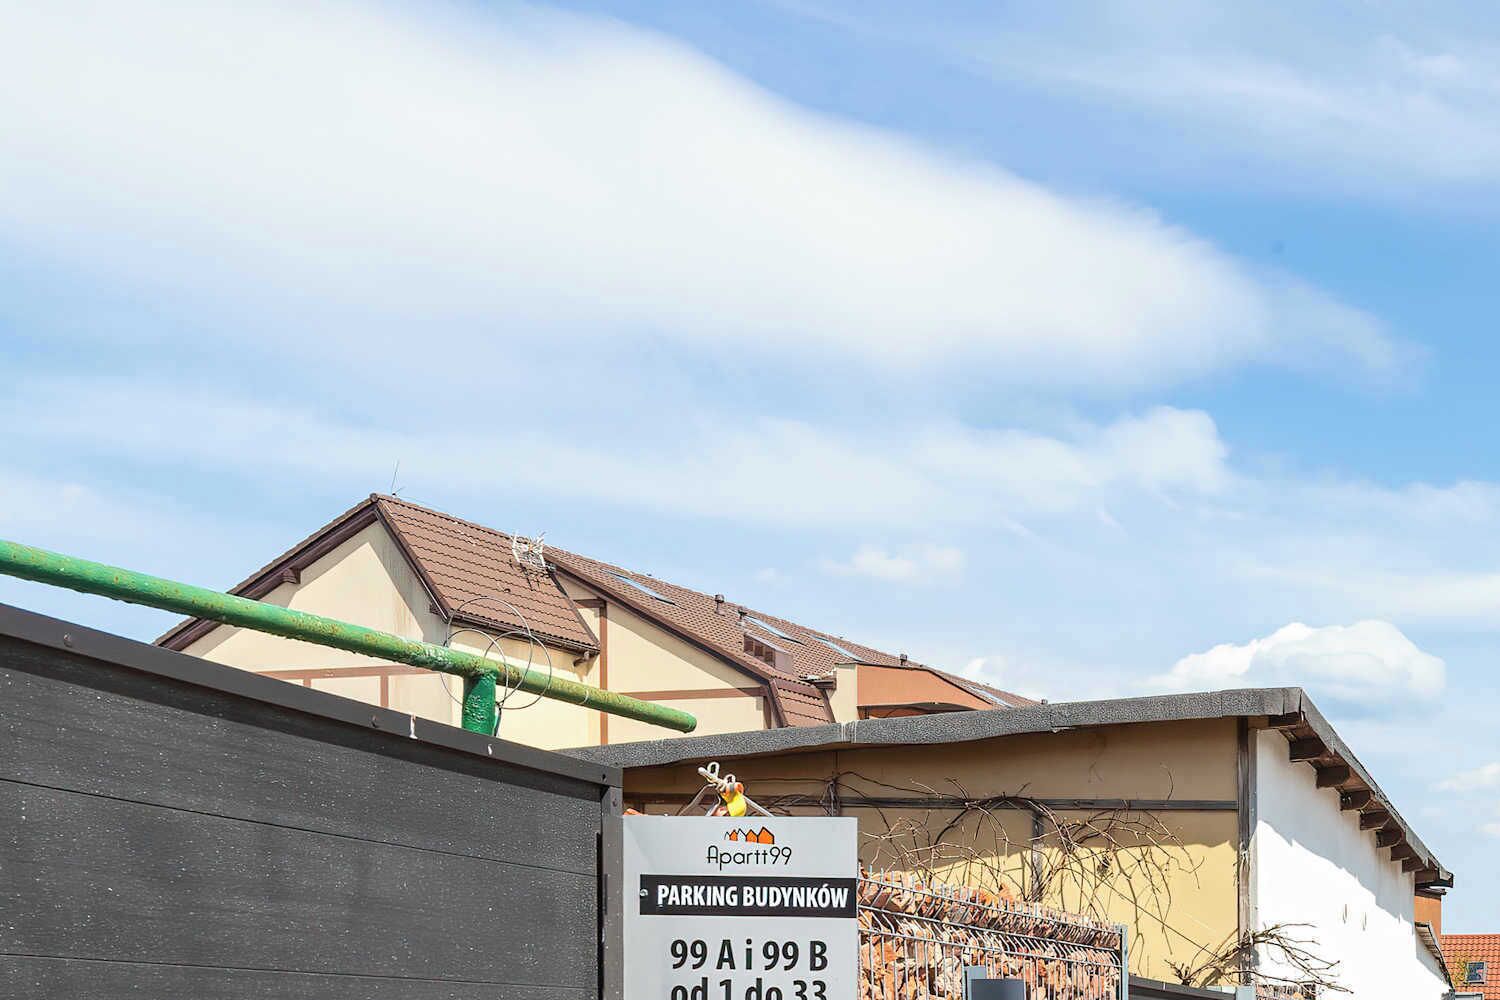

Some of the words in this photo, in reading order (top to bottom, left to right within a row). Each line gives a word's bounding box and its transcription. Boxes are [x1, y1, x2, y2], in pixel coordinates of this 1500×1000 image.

[706, 845, 792, 871] Apartt99
[657, 885, 738, 907] PARKING
[743, 883, 849, 908] BUDYNKÓW
[670, 939, 708, 970] 99
[716, 939, 736, 970] A
[745, 938, 753, 970] i
[762, 941, 799, 971] 99
[809, 940, 828, 972] B
